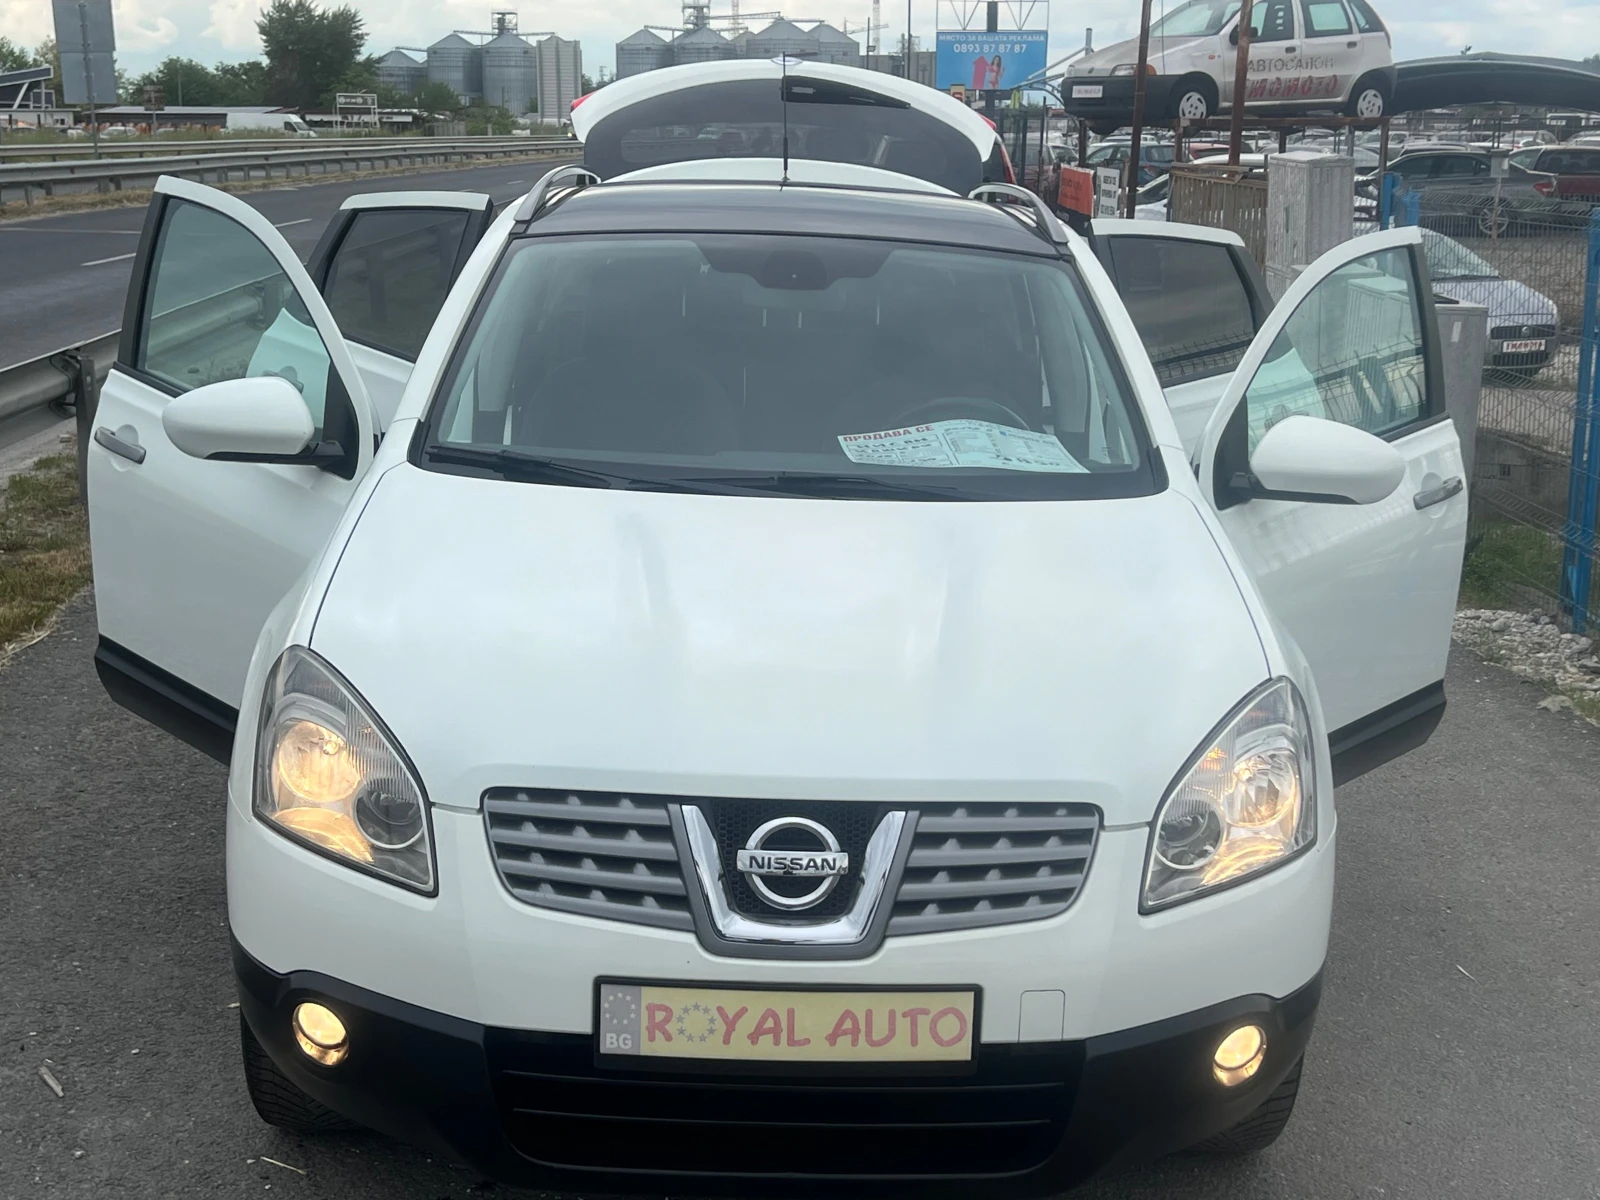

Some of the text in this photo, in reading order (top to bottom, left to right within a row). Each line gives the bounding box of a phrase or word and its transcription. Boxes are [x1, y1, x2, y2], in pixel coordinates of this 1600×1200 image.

[953, 44, 1027, 53] 0893 87 87 87
[843, 429, 912, 442] ПРОДАВА
[915, 424, 934, 433] СЕ
[749, 855, 836, 872] NISSAN
[825, 1006, 968, 1048] AUTO
[605, 1032, 632, 1050] BG
